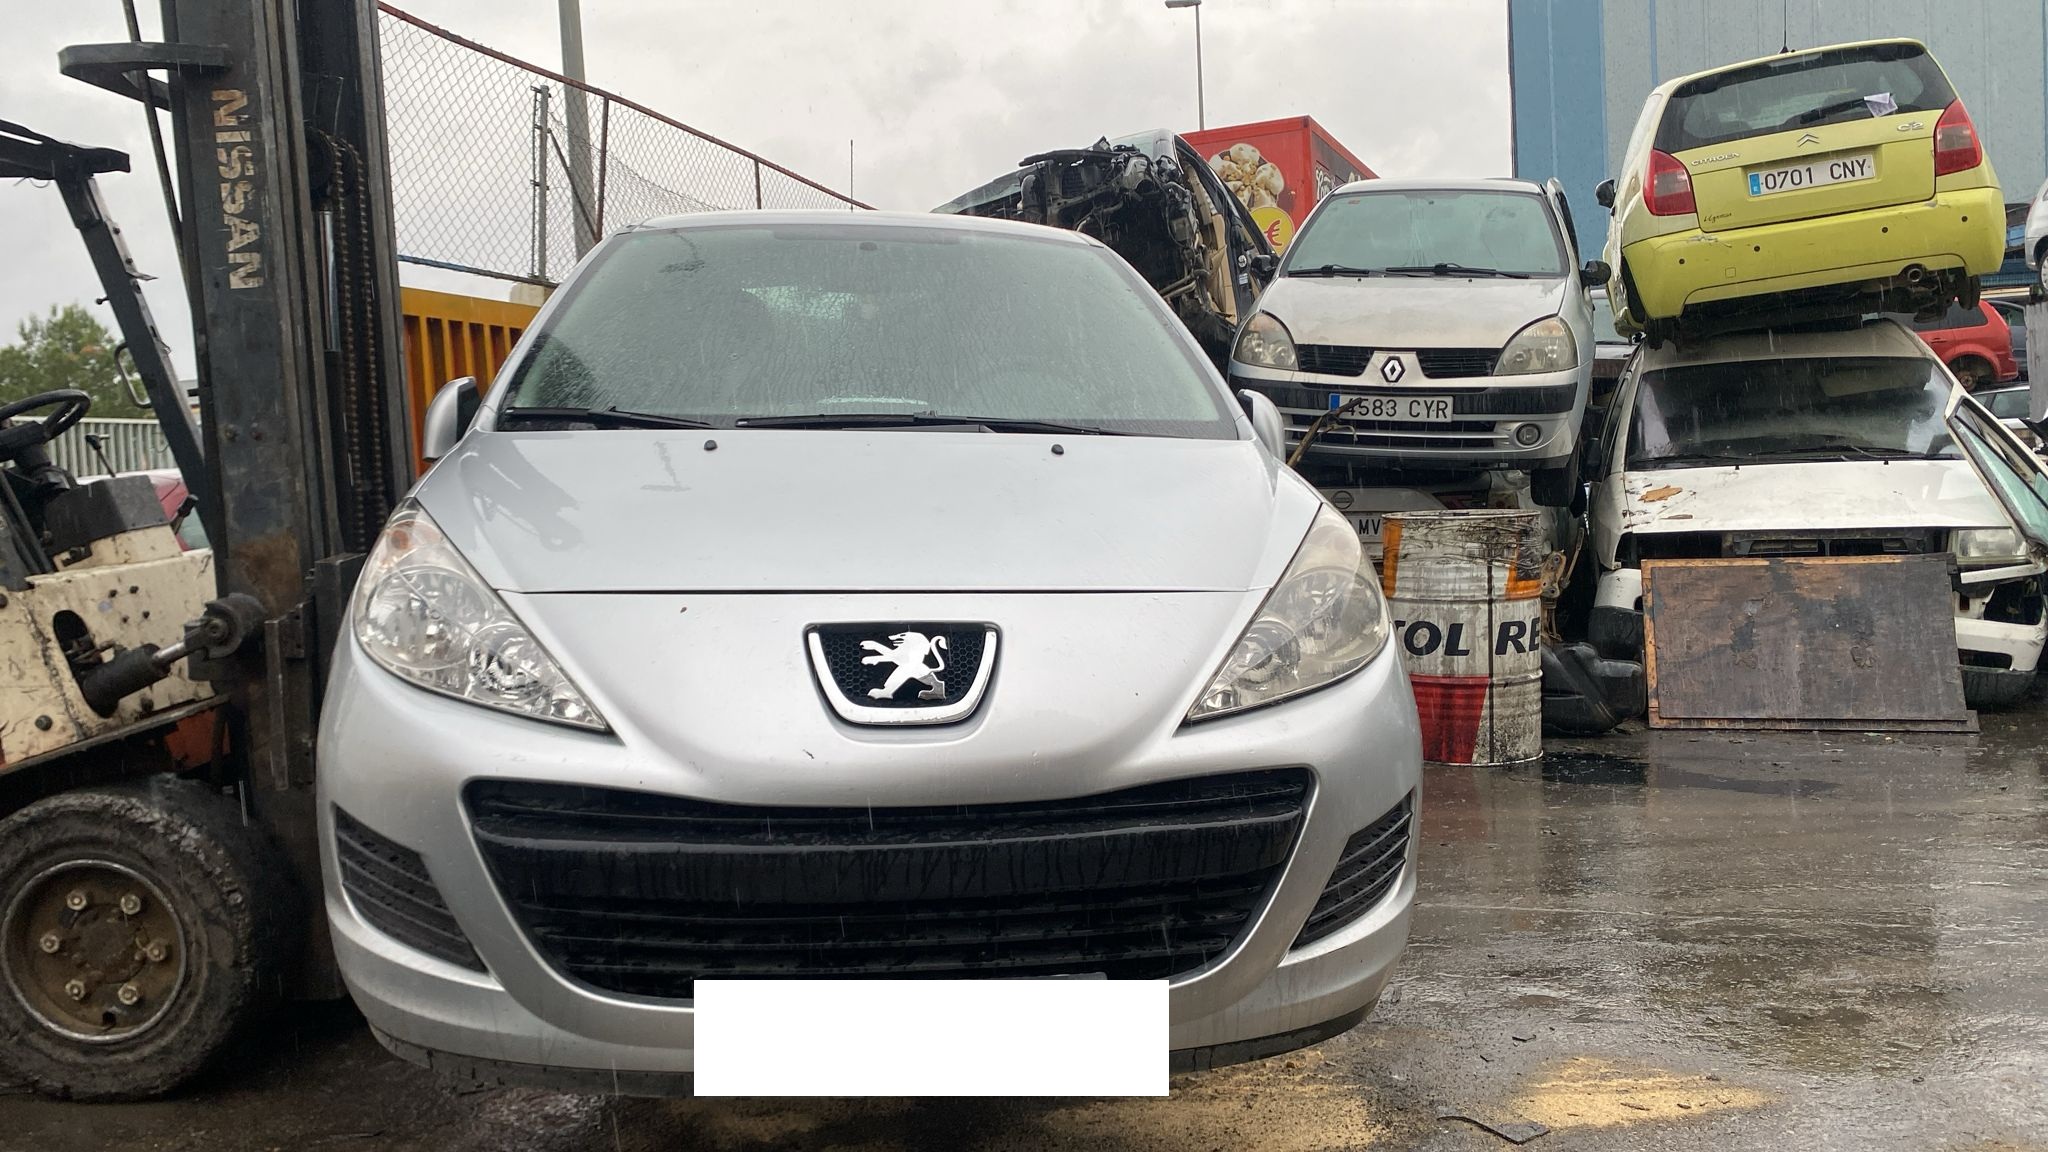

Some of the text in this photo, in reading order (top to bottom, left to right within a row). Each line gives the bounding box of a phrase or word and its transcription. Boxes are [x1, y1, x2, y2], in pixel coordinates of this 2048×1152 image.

[1764, 166, 1814, 190] 0701
[1829, 158, 1867, 180] CNY
[211, 88, 264, 290] NISSAN
[1408, 399, 1449, 419] CYR
[1350, 518, 1382, 535] MV
